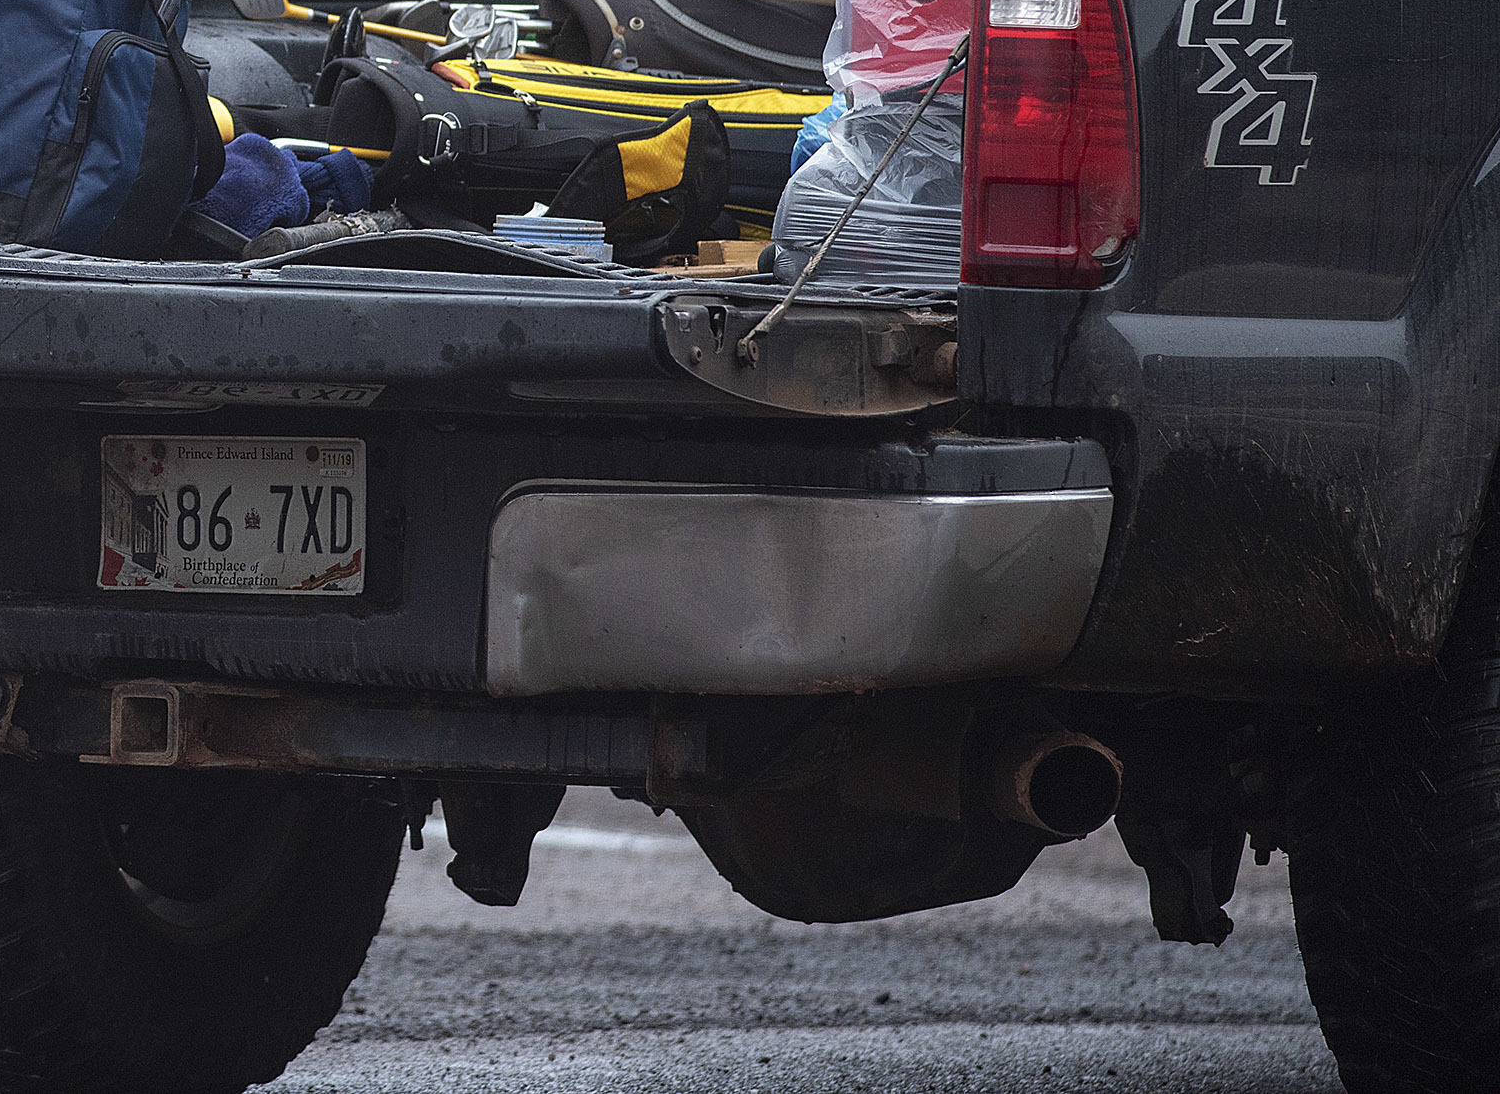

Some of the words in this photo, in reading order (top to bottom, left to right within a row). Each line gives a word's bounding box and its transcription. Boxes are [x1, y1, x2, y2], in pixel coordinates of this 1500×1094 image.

[177, 446, 213, 460] Prince
[216, 446, 257, 461] Edward
[261, 447, 294, 461] Island
[327, 453, 352, 466] 11/19
[176, 484, 233, 552] 86
[269, 485, 353, 554] 7XD
[182, 557, 246, 574] Birthplace
[250, 561, 260, 574] of
[192, 571, 278, 586] Confederation
